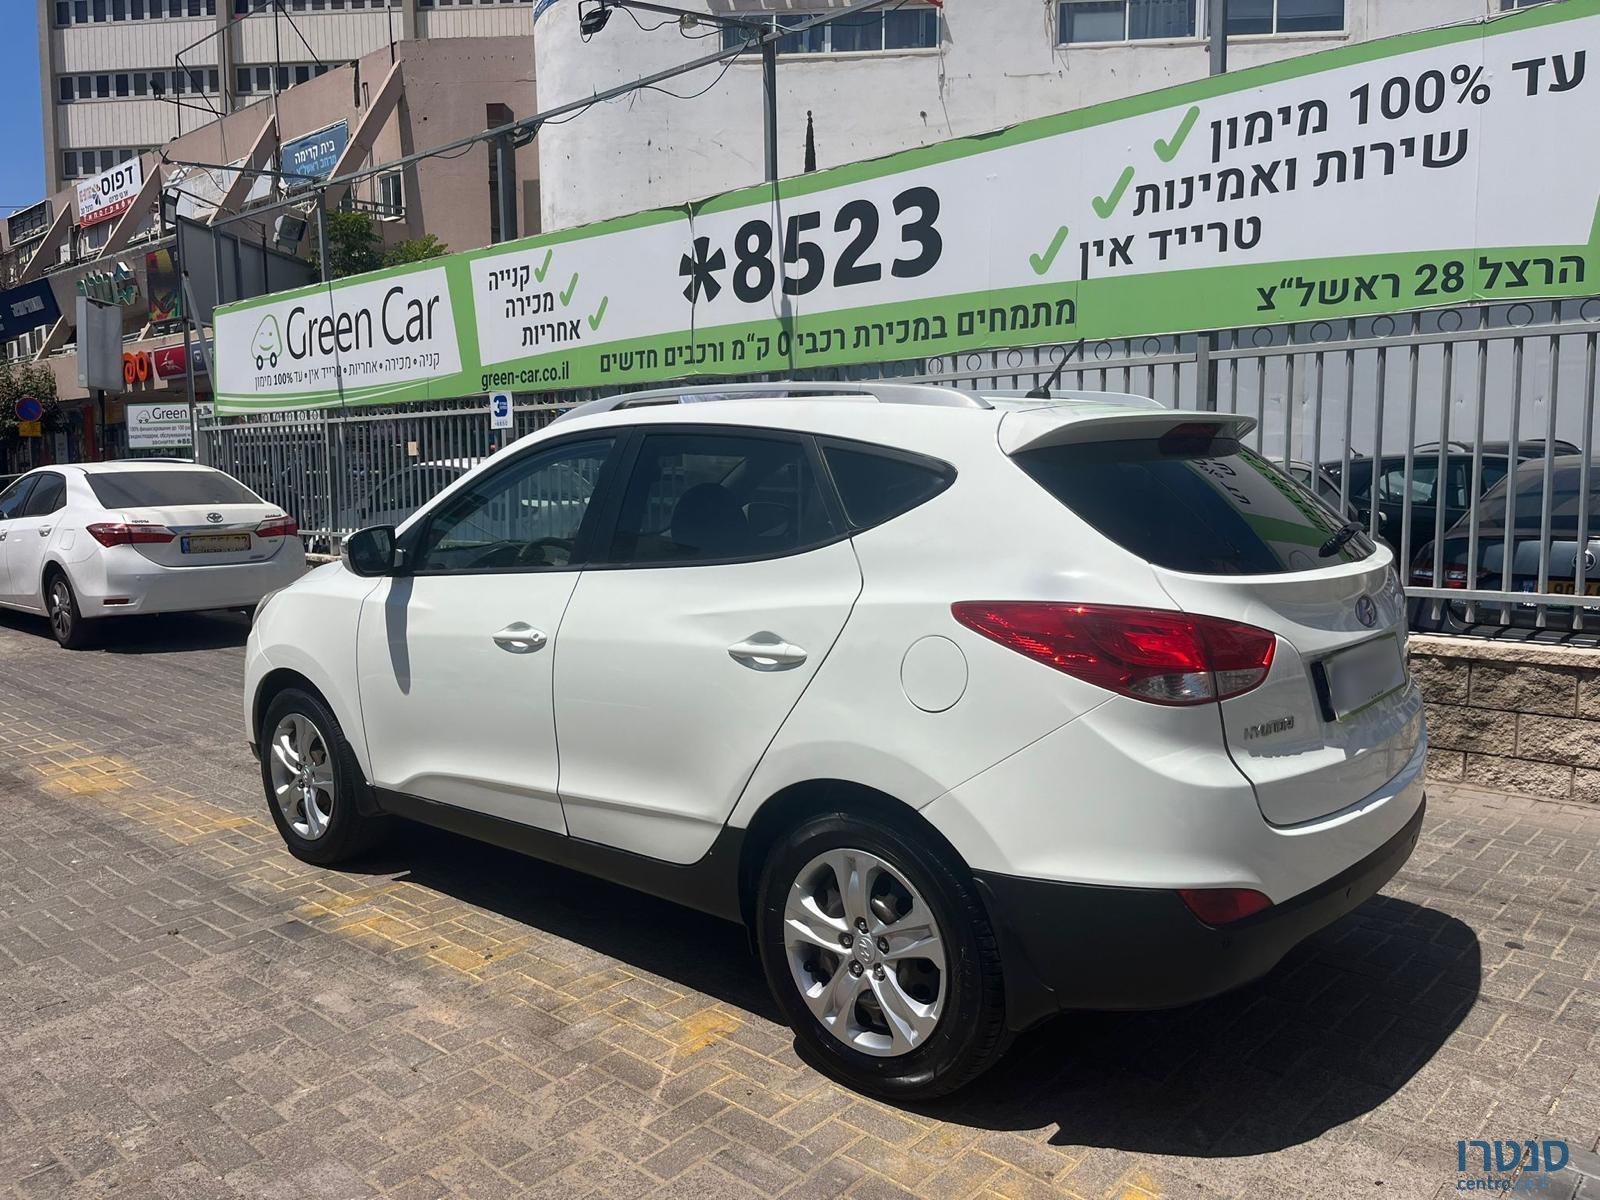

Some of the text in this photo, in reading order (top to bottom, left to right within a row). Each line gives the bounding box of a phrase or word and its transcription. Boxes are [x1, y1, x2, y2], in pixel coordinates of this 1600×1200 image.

[1211, 50, 1586, 163] עד 100% מימון
[294, 140, 335, 165] בית קדימה
[101, 166, 133, 196] דפוס
[1133, 128, 1468, 217] שירות ואמינות
[1079, 215, 1261, 280] טרייד אין
[489, 265, 530, 292] קנייה
[1414, 260, 1465, 296] 28
[1478, 255, 1585, 290] הרצל
[505, 292, 554, 319] מכירה
[958, 298, 1076, 336] מתמחים
[286, 286, 440, 360] Green Car
[521, 319, 581, 347] אחריות
[853, 315, 948, 349] במכירת
[664, 341, 724, 367] ורכבים
[797, 328, 846, 354] רכבי
[349, 361, 378, 376] אחריות
[385, 356, 411, 371] מכירה
[420, 352, 439, 370] קניה
[600, 349, 658, 373] חדשים
[255, 375, 272, 391] מימון
[273, 372, 293, 385] 100%
[294, 371, 303, 382] עד
[309, 368, 319, 384] אין
[481, 362, 570, 391] green-car.co.il
[152, 407, 187, 419] Green
